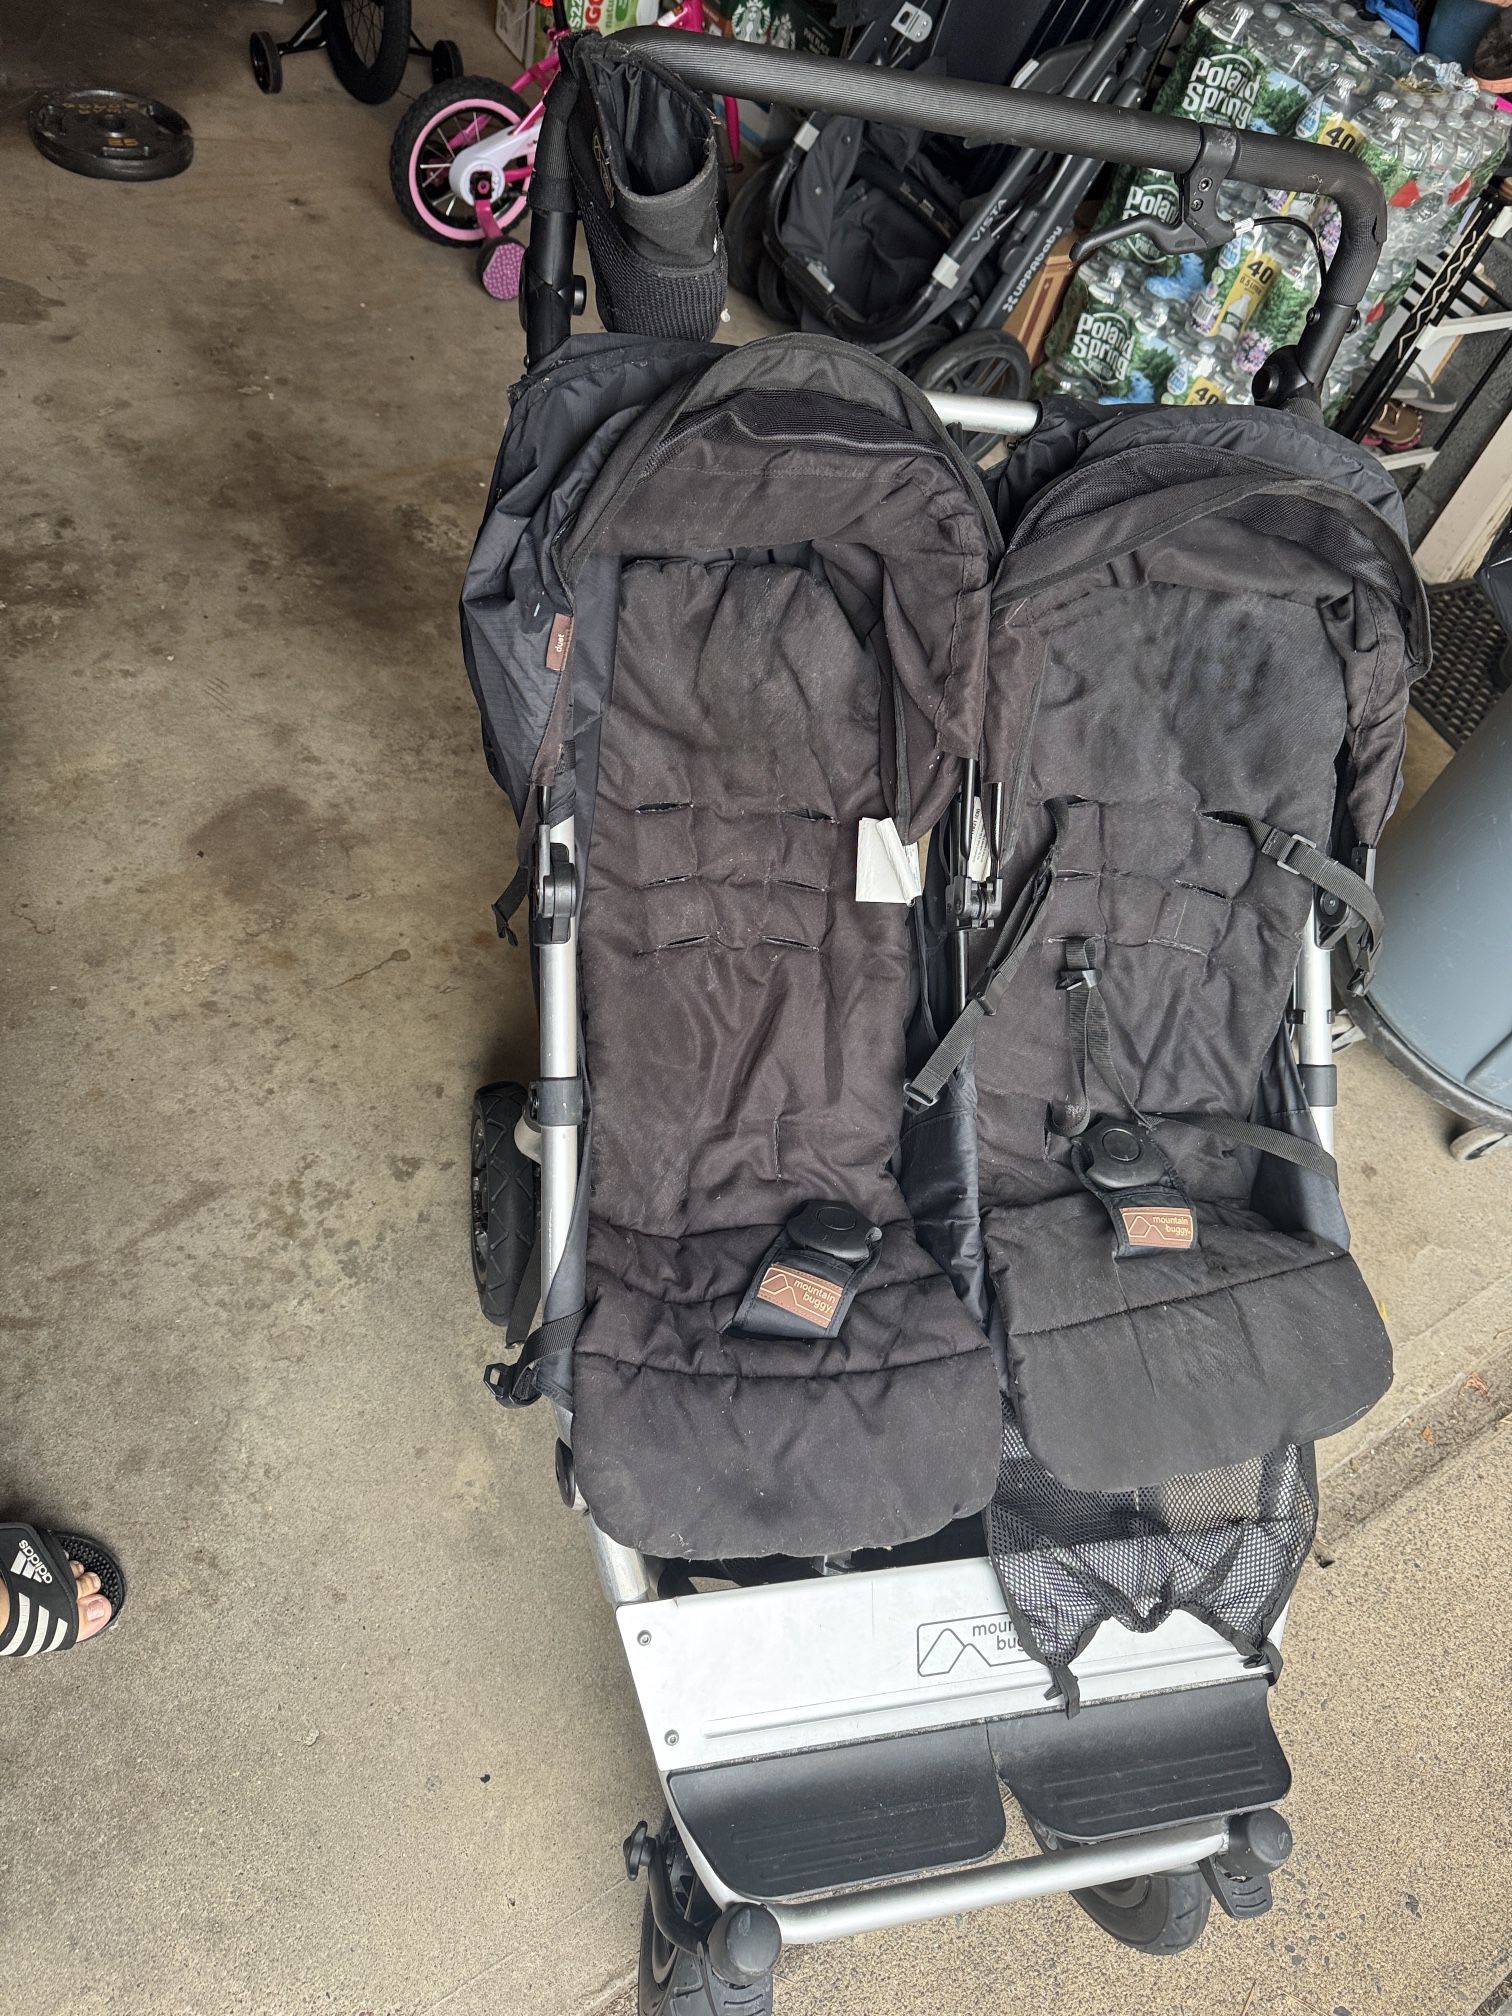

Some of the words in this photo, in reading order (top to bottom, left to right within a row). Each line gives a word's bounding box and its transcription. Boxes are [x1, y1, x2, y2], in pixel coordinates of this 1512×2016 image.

[1190, 56, 1261, 104] Poland
[1182, 82, 1252, 129] Spring
[1326, 127, 1356, 152] 40
[1124, 185, 1180, 225] Polan
[971, 199, 1008, 242] VISTA
[1248, 260, 1274, 285] 40
[1076, 313, 1135, 360] Poland
[1071, 334, 1129, 381] Spring
[1195, 387, 1219, 404] 40
[1152, 1215, 1189, 1225] mountain
[1165, 1223, 1189, 1236] buggy
[793, 1279, 836, 1304] mountain
[802, 1291, 833, 1313] buggy
[18, 1539, 53, 1584] adidas
[972, 1620, 1015, 1637] moun
